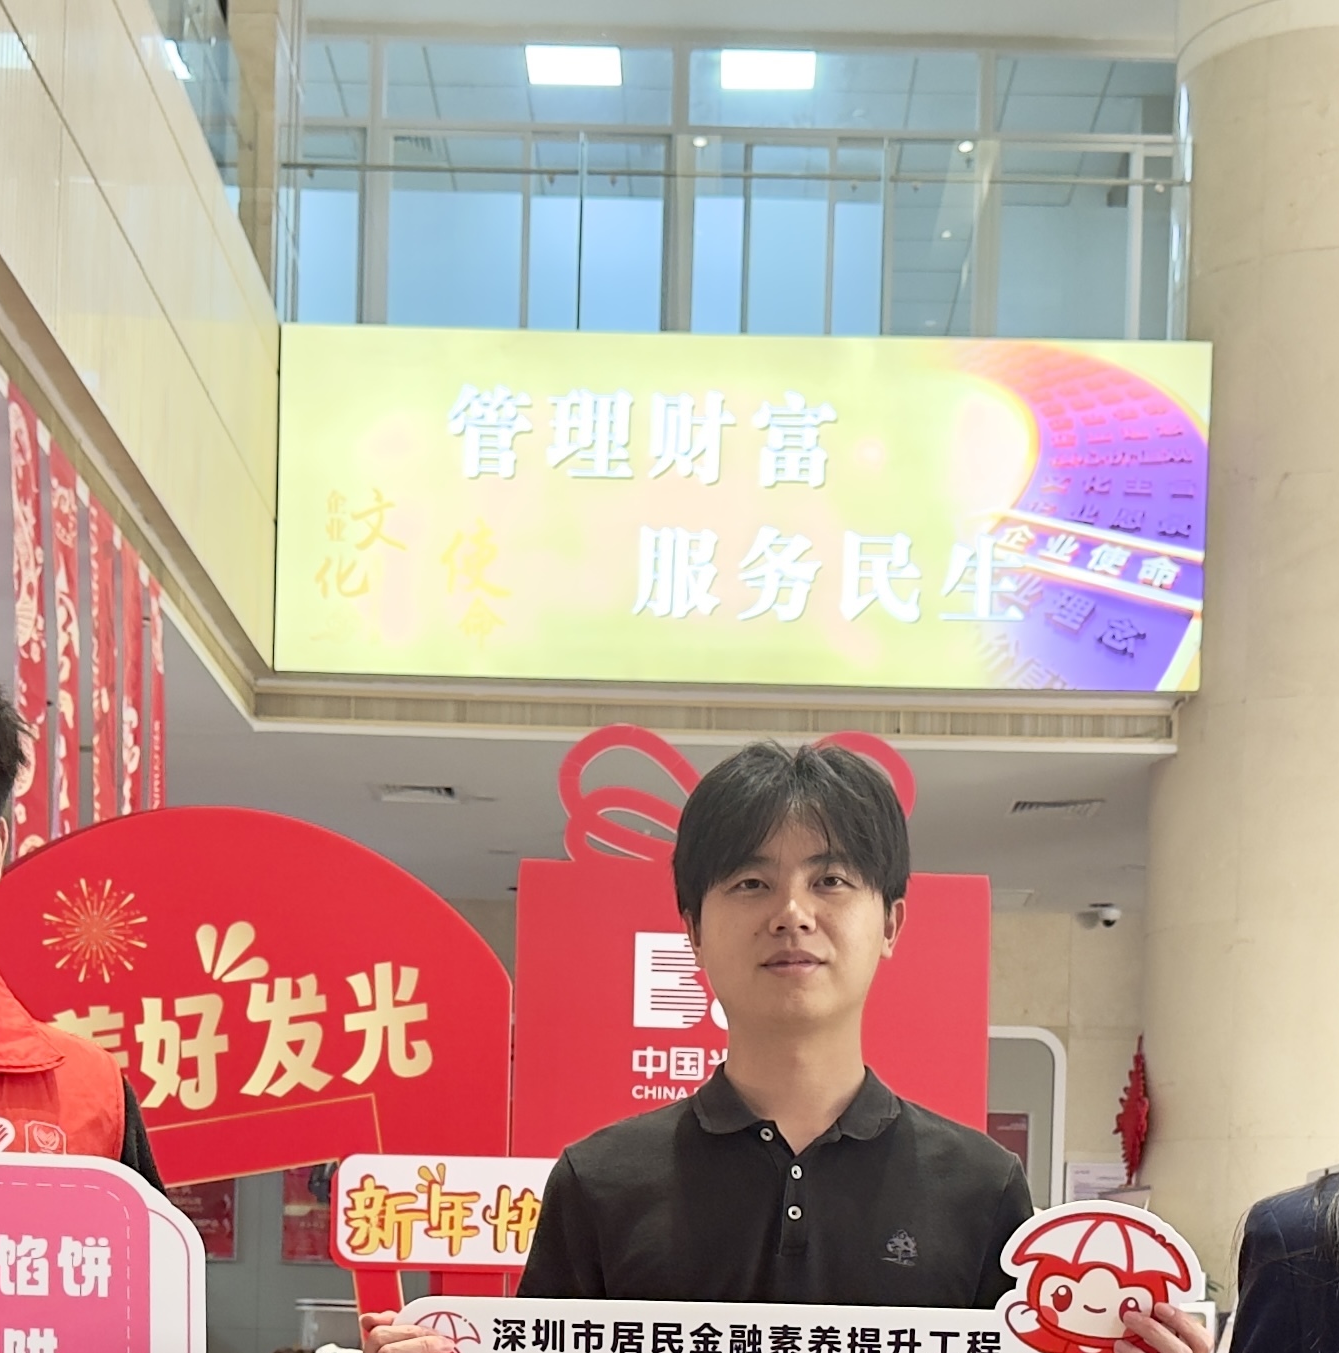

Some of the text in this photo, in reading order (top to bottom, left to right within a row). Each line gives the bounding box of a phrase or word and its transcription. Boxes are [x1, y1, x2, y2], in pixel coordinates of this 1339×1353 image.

[447, 381, 839, 489] 管理财富
[633, 524, 1026, 624] 服务民生
[995, 524, 1182, 591] 企业使命
